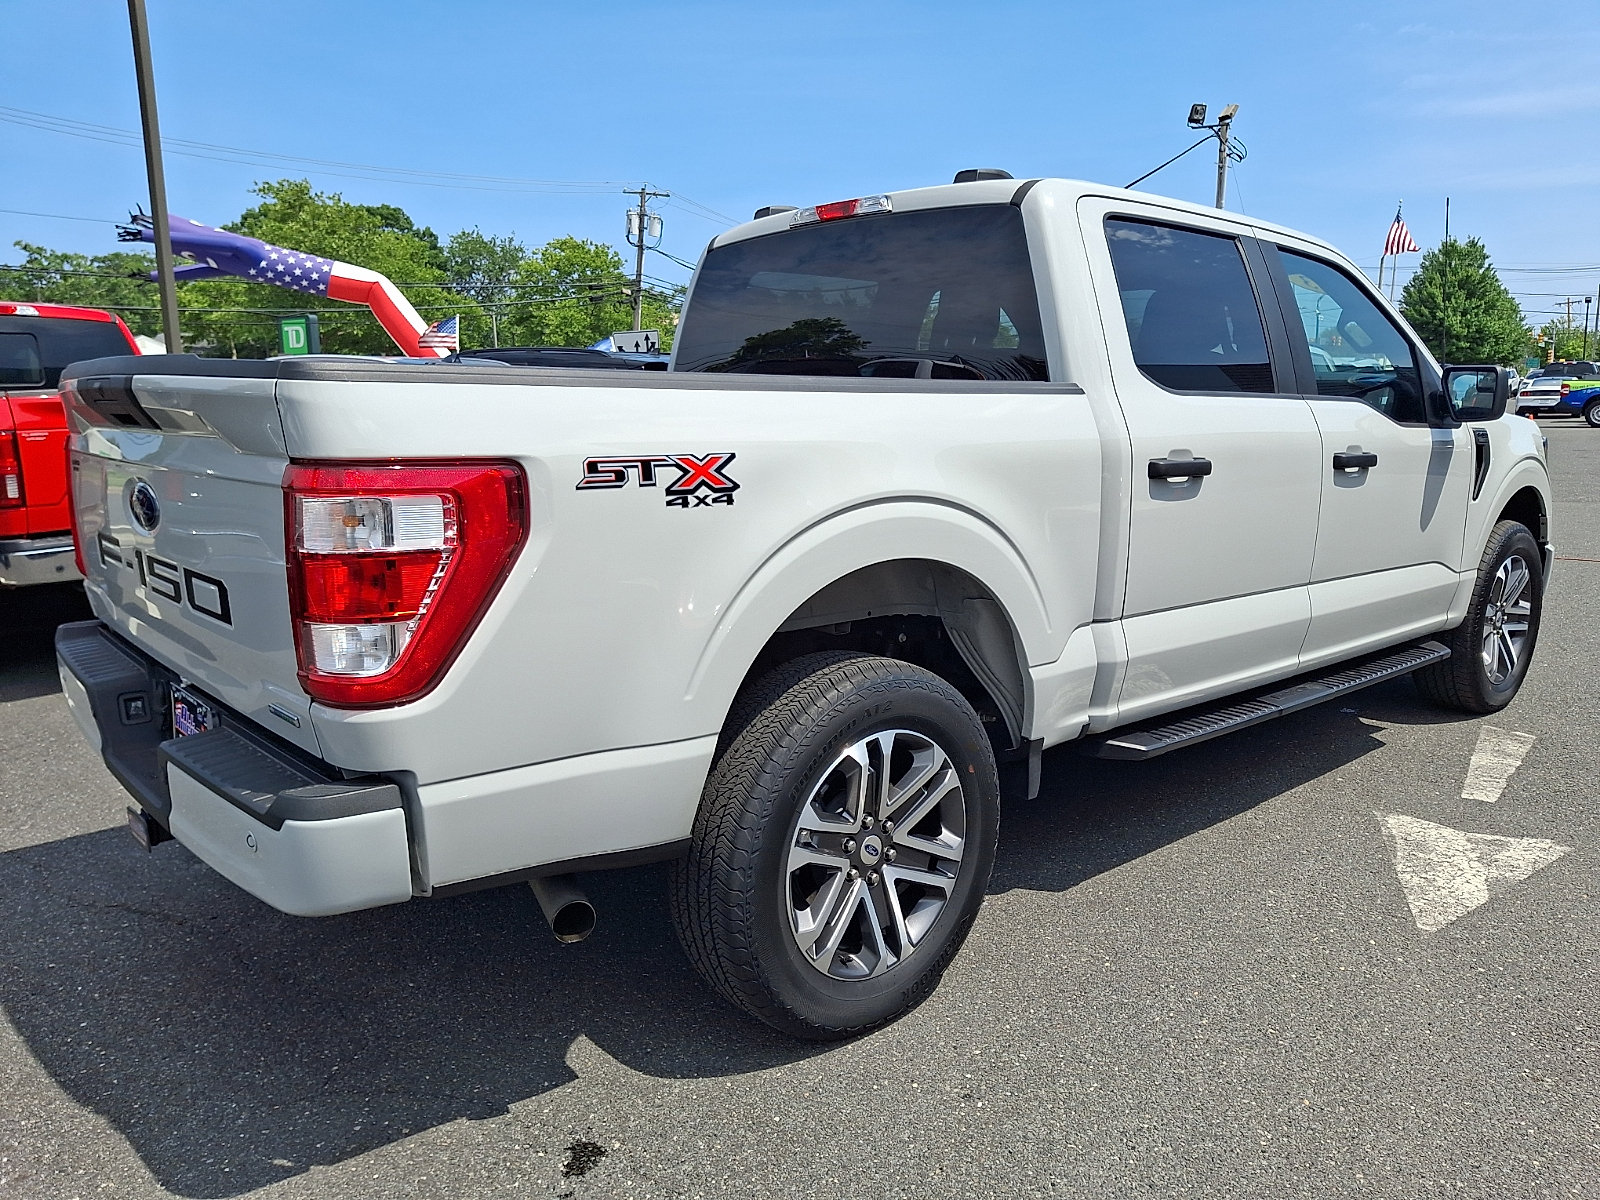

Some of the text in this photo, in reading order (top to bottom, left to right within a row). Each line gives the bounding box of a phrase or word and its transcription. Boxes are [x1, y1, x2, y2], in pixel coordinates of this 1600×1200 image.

[283, 326, 305, 349] TD
[575, 452, 741, 496] STX
[98, 532, 234, 628] F-150
